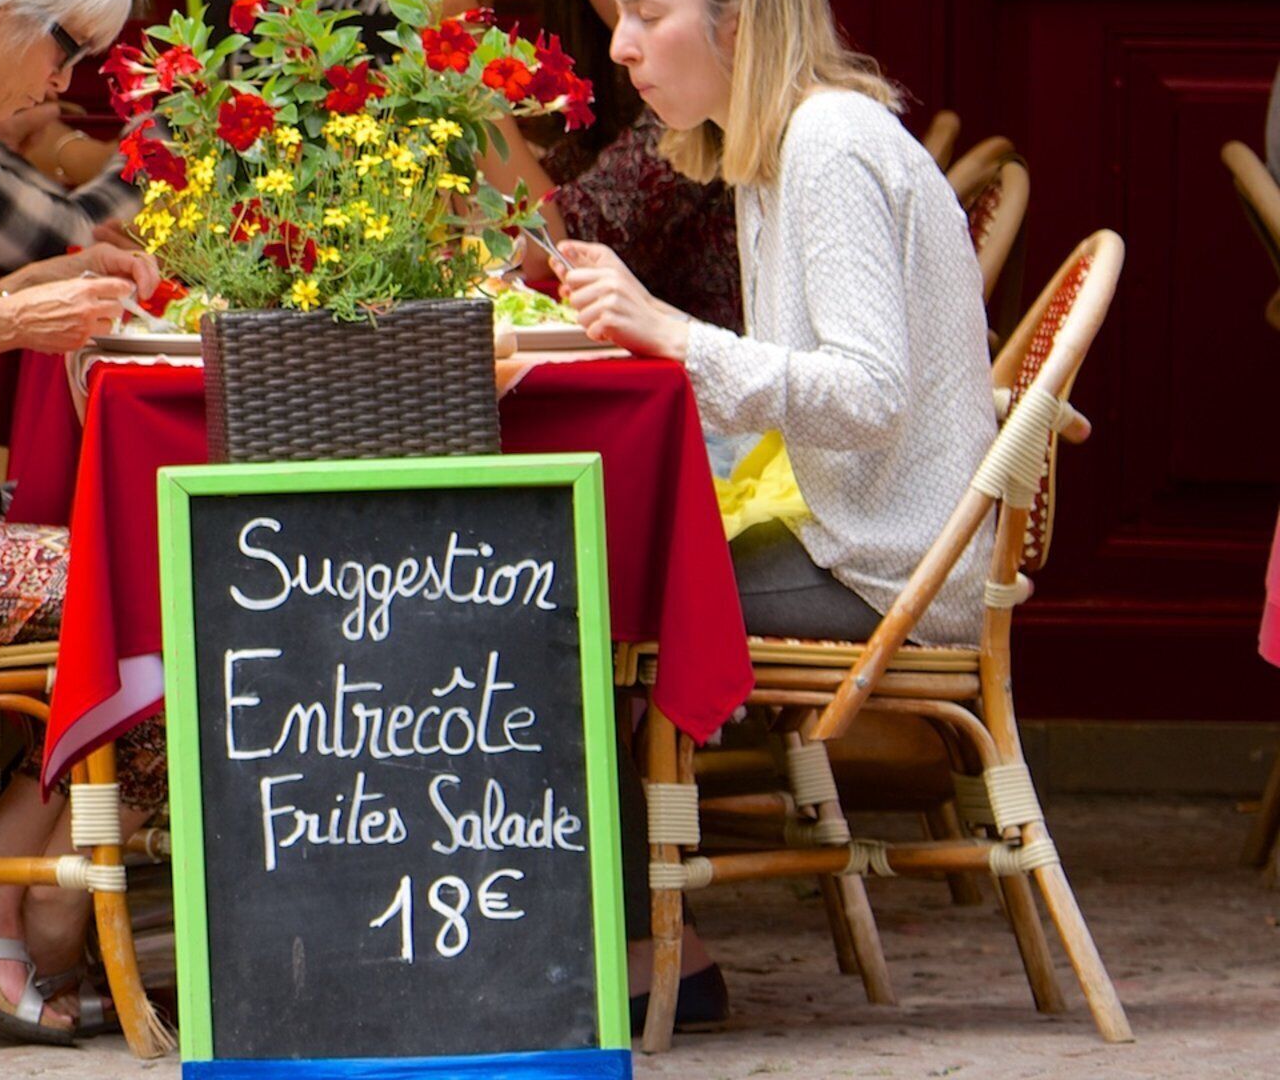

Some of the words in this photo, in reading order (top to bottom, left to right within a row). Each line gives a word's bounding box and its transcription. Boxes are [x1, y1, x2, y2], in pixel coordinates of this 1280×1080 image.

[229, 517, 557, 642] Suggestion
[224, 648, 543, 760] Entrecôte
[260, 771, 407, 872] Frites
[369, 868, 526, 965] 18€
